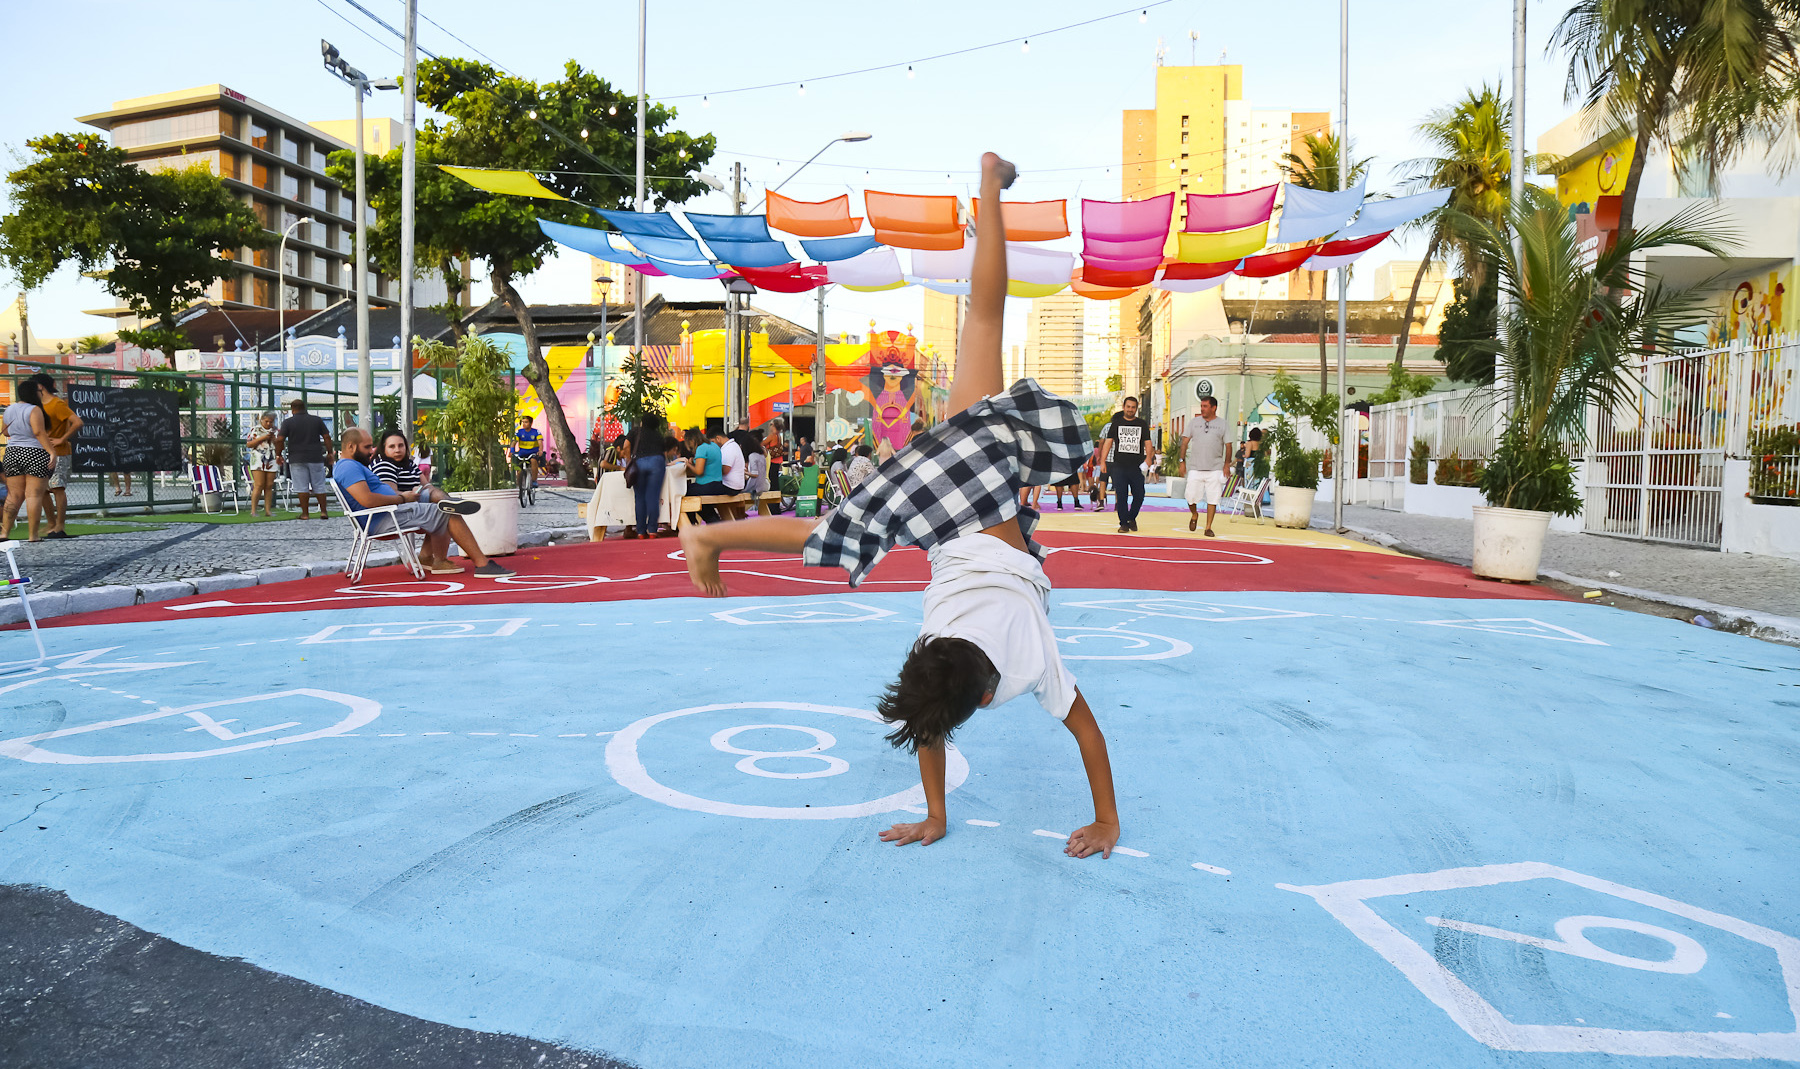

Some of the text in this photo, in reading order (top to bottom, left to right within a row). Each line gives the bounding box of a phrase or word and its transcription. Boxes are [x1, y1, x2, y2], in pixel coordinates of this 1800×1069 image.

[72, 390, 106, 405] QUANDO
[1119, 427, 1141, 436] JUST
[1119, 436, 1140, 444] START
[1119, 444, 1139, 452] NOW
[710, 724, 850, 780] 8
